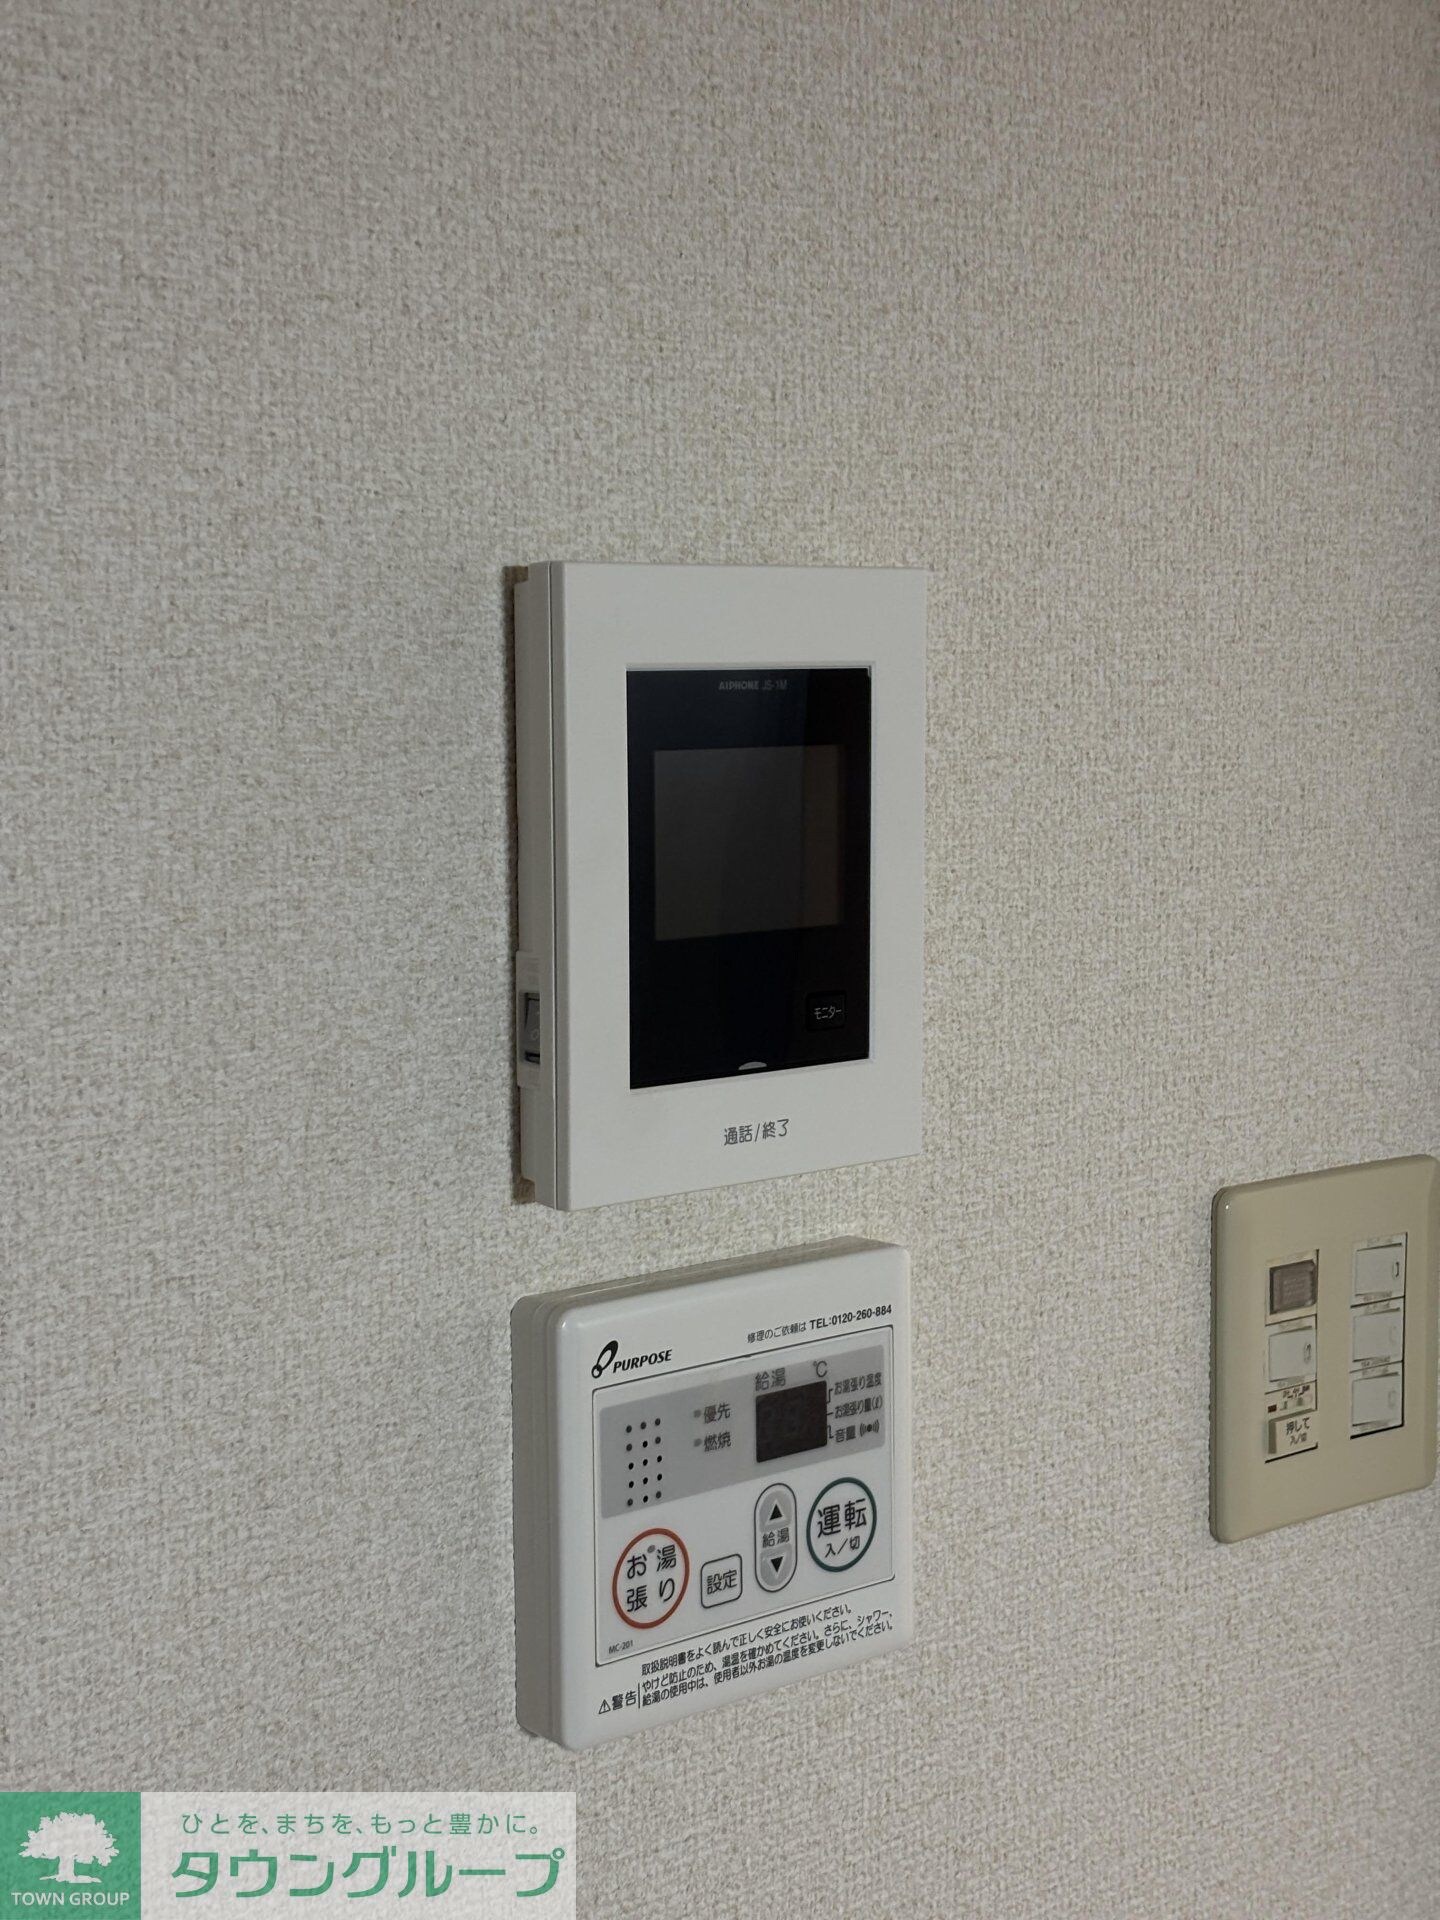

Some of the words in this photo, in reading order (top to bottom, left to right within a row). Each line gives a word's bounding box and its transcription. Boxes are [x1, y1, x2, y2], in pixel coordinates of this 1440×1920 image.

[813, 1005, 842, 1020] モニター
[723, 1118, 790, 1146] 通話/終了
[747, 1322, 807, 1343] 修理のご依頼は
[809, 1304, 892, 1330] TEL:0120-260-884
[612, 1349, 672, 1374] PURPOSE
[755, 1367, 786, 1392] 給湯
[703, 1431, 732, 1452] 燃焼
[817, 1498, 868, 1538] 運転
[762, 1527, 790, 1548] 給湯
[626, 1544, 677, 1580] お湯
[626, 1577, 676, 1613] 張り
[706, 1570, 738, 1595] 設定
[611, 1690, 637, 1712] 警告
